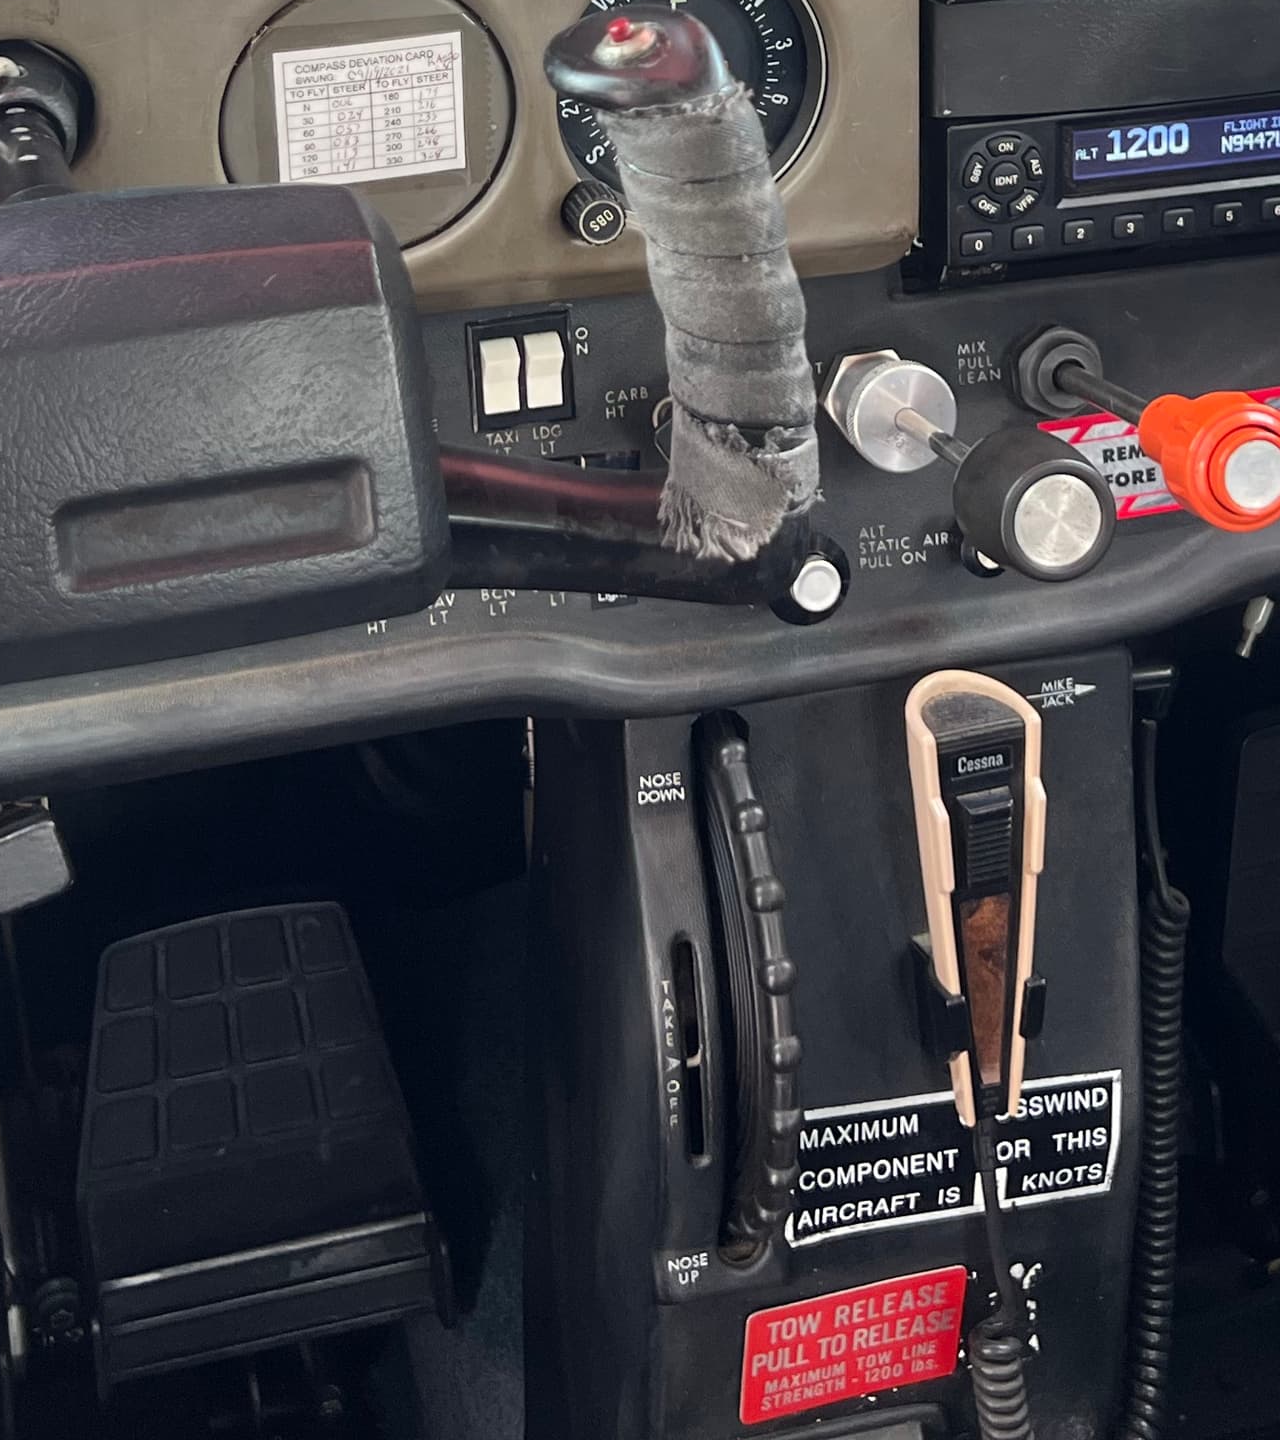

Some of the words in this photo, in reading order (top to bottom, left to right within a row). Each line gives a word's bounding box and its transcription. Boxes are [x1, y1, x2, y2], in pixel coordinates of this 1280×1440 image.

[295, 60, 346, 74] COMPASS
[349, 54, 403, 68] DEVIATION
[405, 50, 433, 61] CARD
[1224, 118, 1267, 132] FLIGHT
[998, 143, 1014, 152] ON
[1075, 147, 1098, 161] ALT
[1106, 123, 1189, 161] 1200
[994, 173, 1018, 186] IDNT
[957, 341, 986, 356] MIX
[957, 357, 993, 371] PULL
[959, 368, 1001, 385] LEAN
[859, 525, 885, 539] ALT
[858, 536, 911, 552] STATIC
[923, 532, 949, 546] AIR
[859, 552, 892, 568] PULL
[902, 549, 927, 564] ON
[1041, 678, 1074, 693] MIKE
[1041, 693, 1074, 708] JACK
[958, 752, 1004, 774] Cessna
[639, 772, 681, 789] NOSE
[638, 786, 685, 804] DOWN
[800, 1115, 919, 1150] MAXIMUM
[799, 1149, 958, 1192] COMPONENT
[1052, 1127, 1107, 1153] THIS
[797, 1193, 921, 1231] AIRCRAFT
[938, 1186, 961, 1206] IS
[1022, 1163, 1103, 1192] KNOTS
[668, 1253, 708, 1273] NOSE
[679, 1269, 699, 1285] UP
[767, 1313, 820, 1343] TOW
[834, 1281, 948, 1325] RELEASE
[752, 1342, 808, 1376] PULL
[819, 1337, 846, 1361] TO
[853, 1308, 955, 1350] RELEASE
[765, 1363, 846, 1394] MAXIMUM
[856, 1350, 892, 1371] TOW
[903, 1340, 936, 1361] LINE
[761, 1378, 846, 1411] STRENGTH
[865, 1365, 902, 1384] 1200
